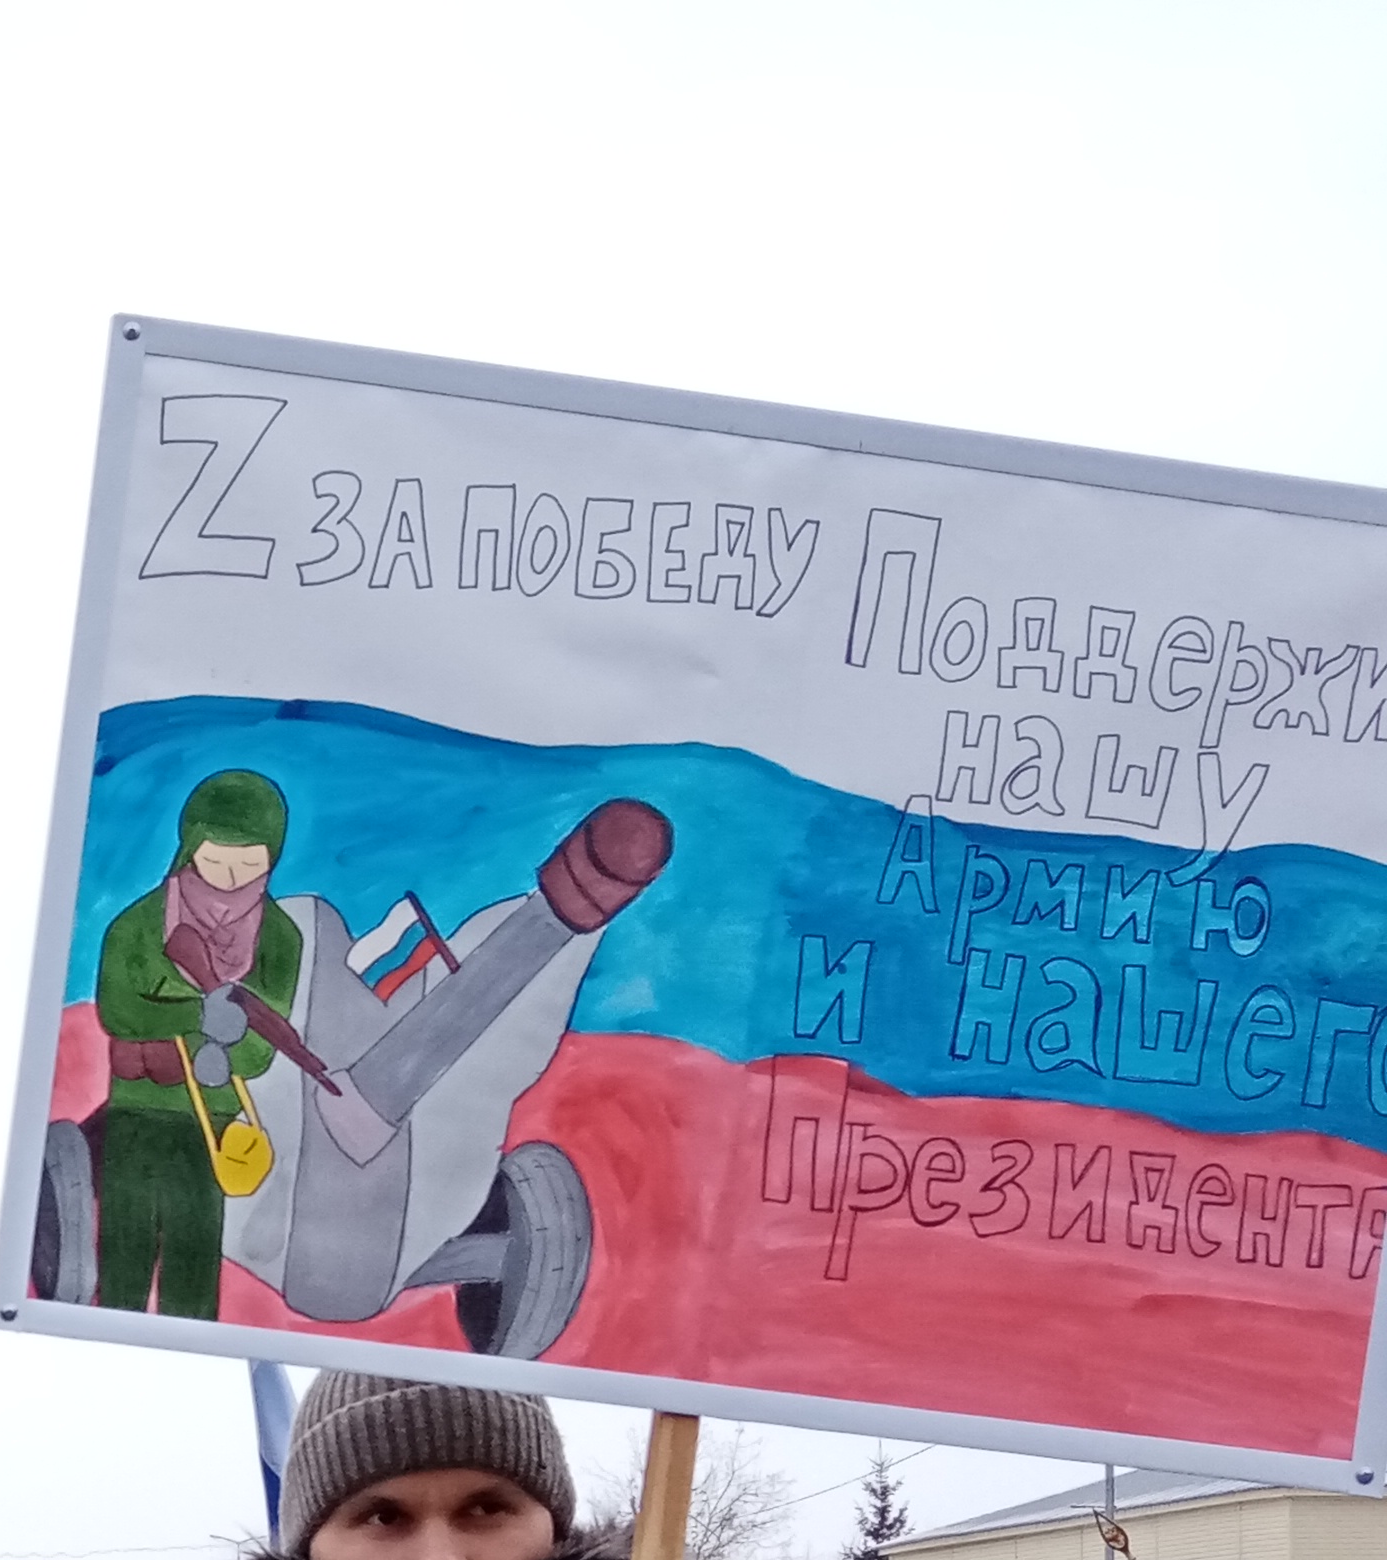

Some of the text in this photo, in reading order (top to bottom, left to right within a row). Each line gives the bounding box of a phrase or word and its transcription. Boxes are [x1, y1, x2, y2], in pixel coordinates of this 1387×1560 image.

[138, 394, 288, 579] Z
[296, 470, 433, 590] ЗА
[458, 483, 820, 618] ПОБЕДУ
[876, 794, 1273, 965] Армию
[932, 709, 1270, 887] нашу
[793, 934, 875, 1044] и
